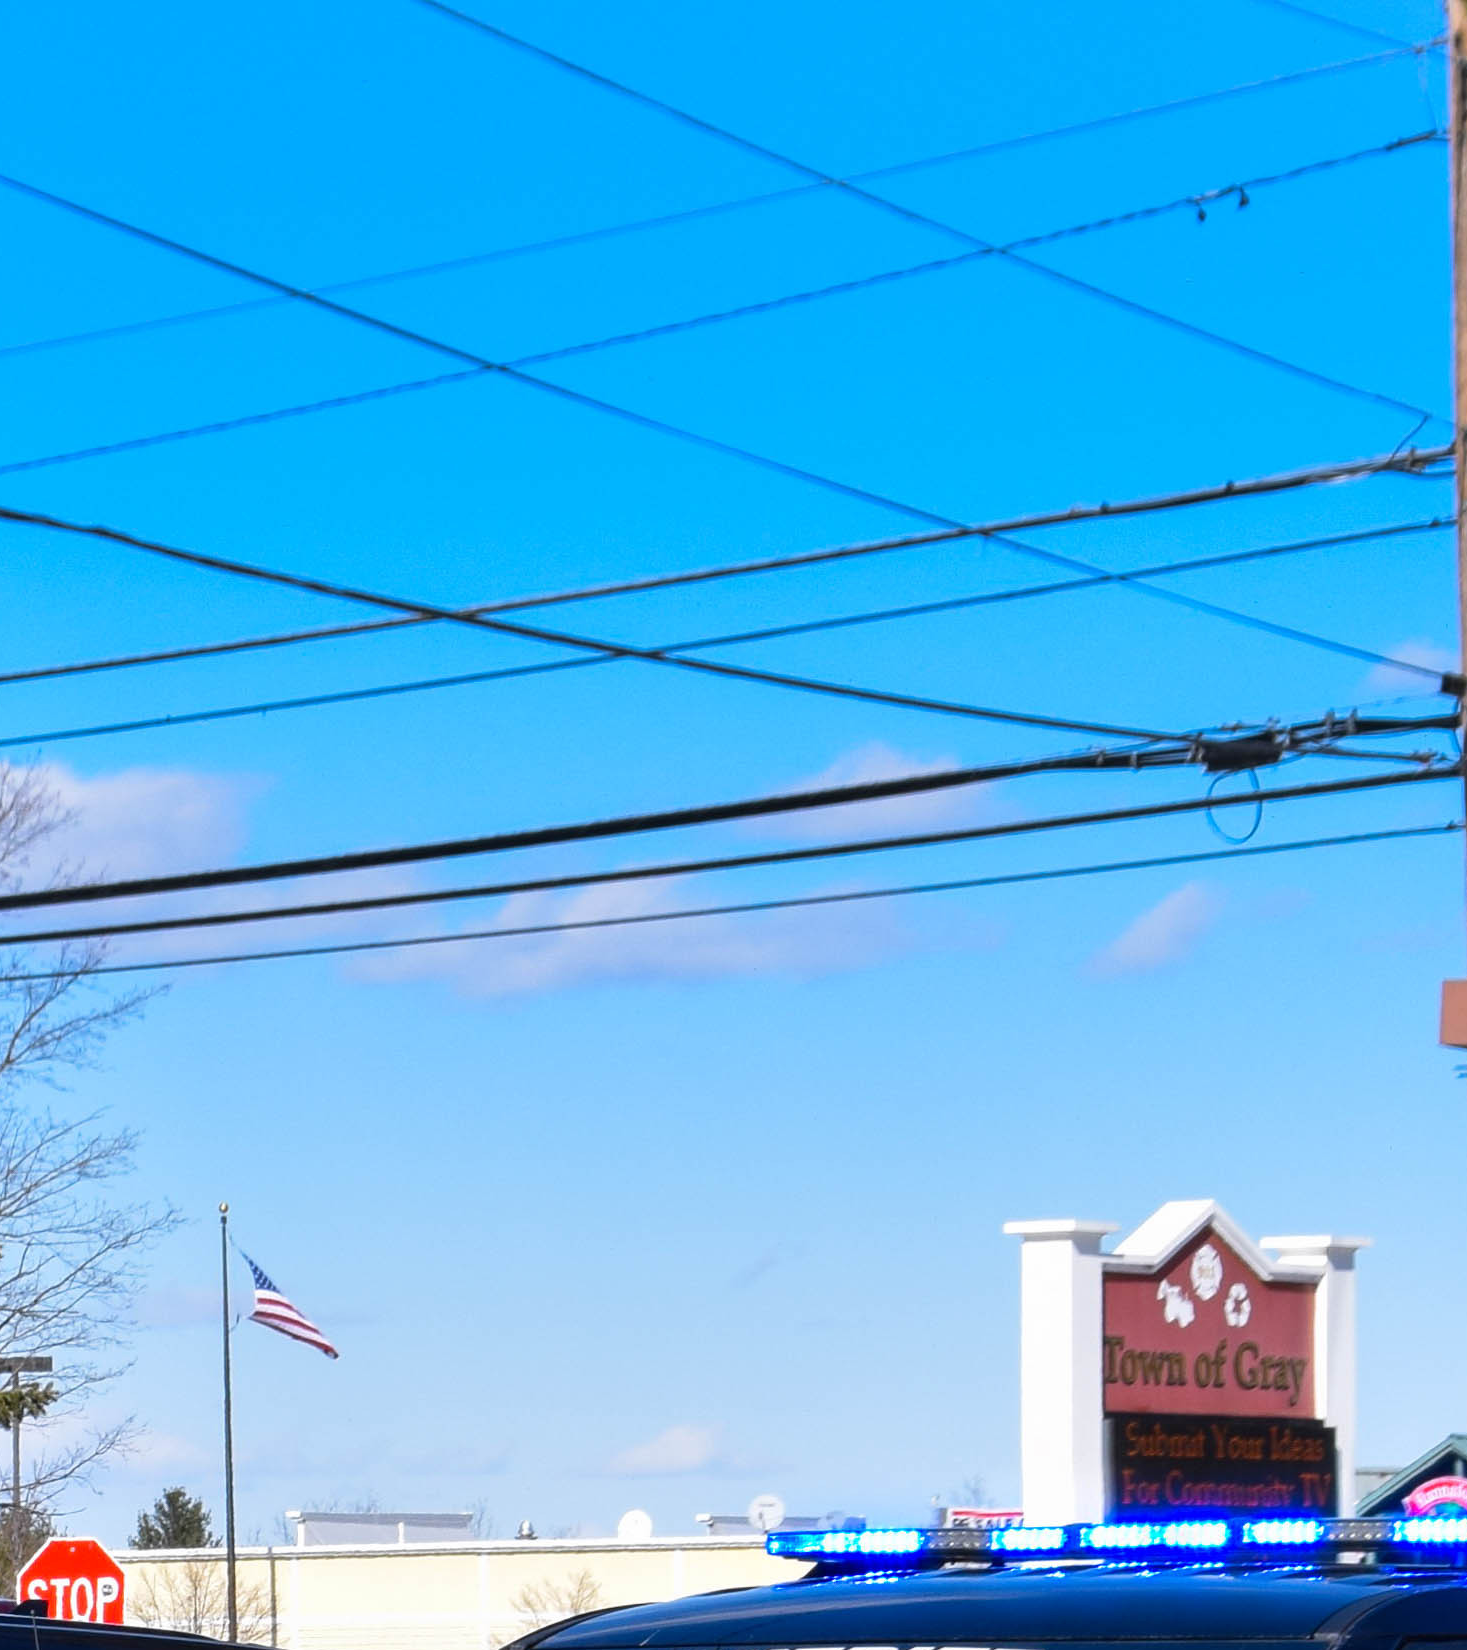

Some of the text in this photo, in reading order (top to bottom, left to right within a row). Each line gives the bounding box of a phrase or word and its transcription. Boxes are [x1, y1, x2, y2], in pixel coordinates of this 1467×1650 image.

[1104, 1336, 1307, 1406] Town of Gray
[1126, 1421, 1325, 1461] Submit Your Ideas
[1122, 1469, 1160, 1505] For
[1299, 1472, 1331, 1507] TV
